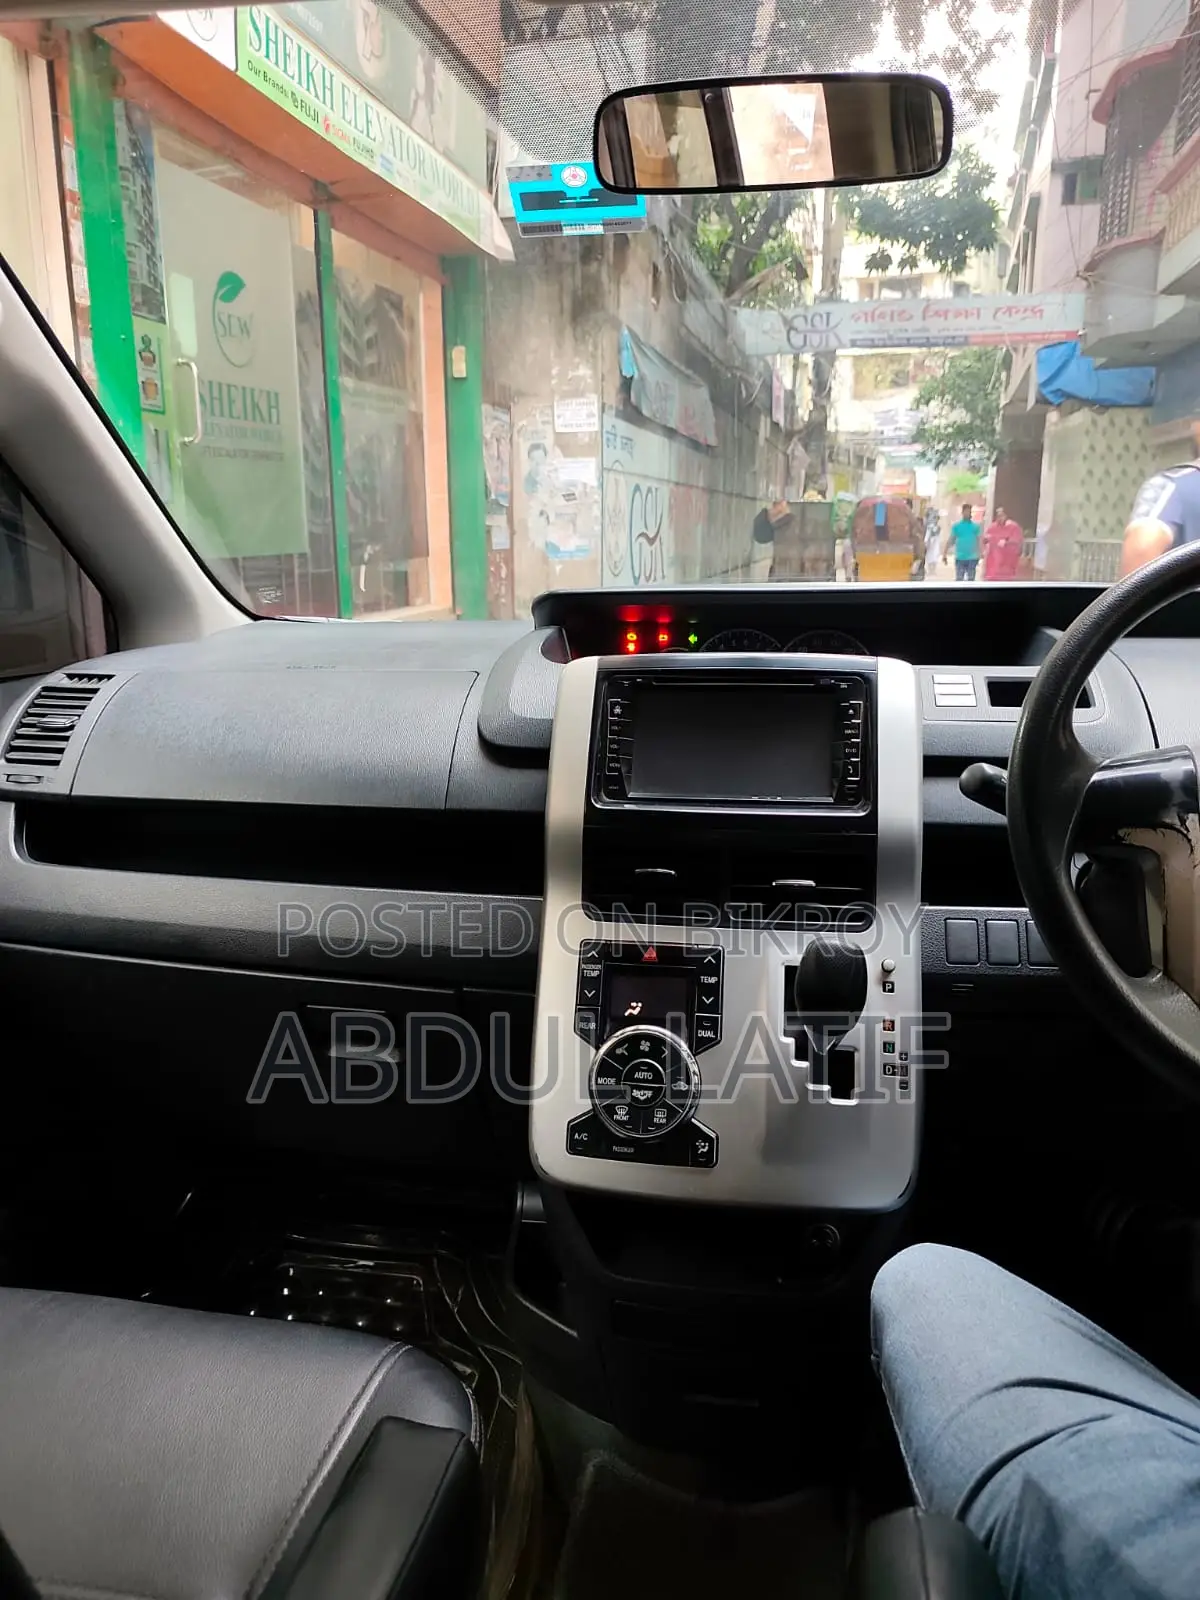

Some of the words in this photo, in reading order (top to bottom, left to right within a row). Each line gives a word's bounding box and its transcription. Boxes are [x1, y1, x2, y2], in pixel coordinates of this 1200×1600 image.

[247, 59, 262, 78] Our
[248, 5, 336, 112] SHEIKH
[340, 81, 428, 180] ELEVATOR
[300, 98, 320, 124] FUJI
[885, 983, 893, 992] P
[579, 1021, 596, 1029] REAR
[697, 1029, 716, 1038] DUAL
[634, 1070, 653, 1080] AUTO
[597, 1077, 616, 1085] MODE
